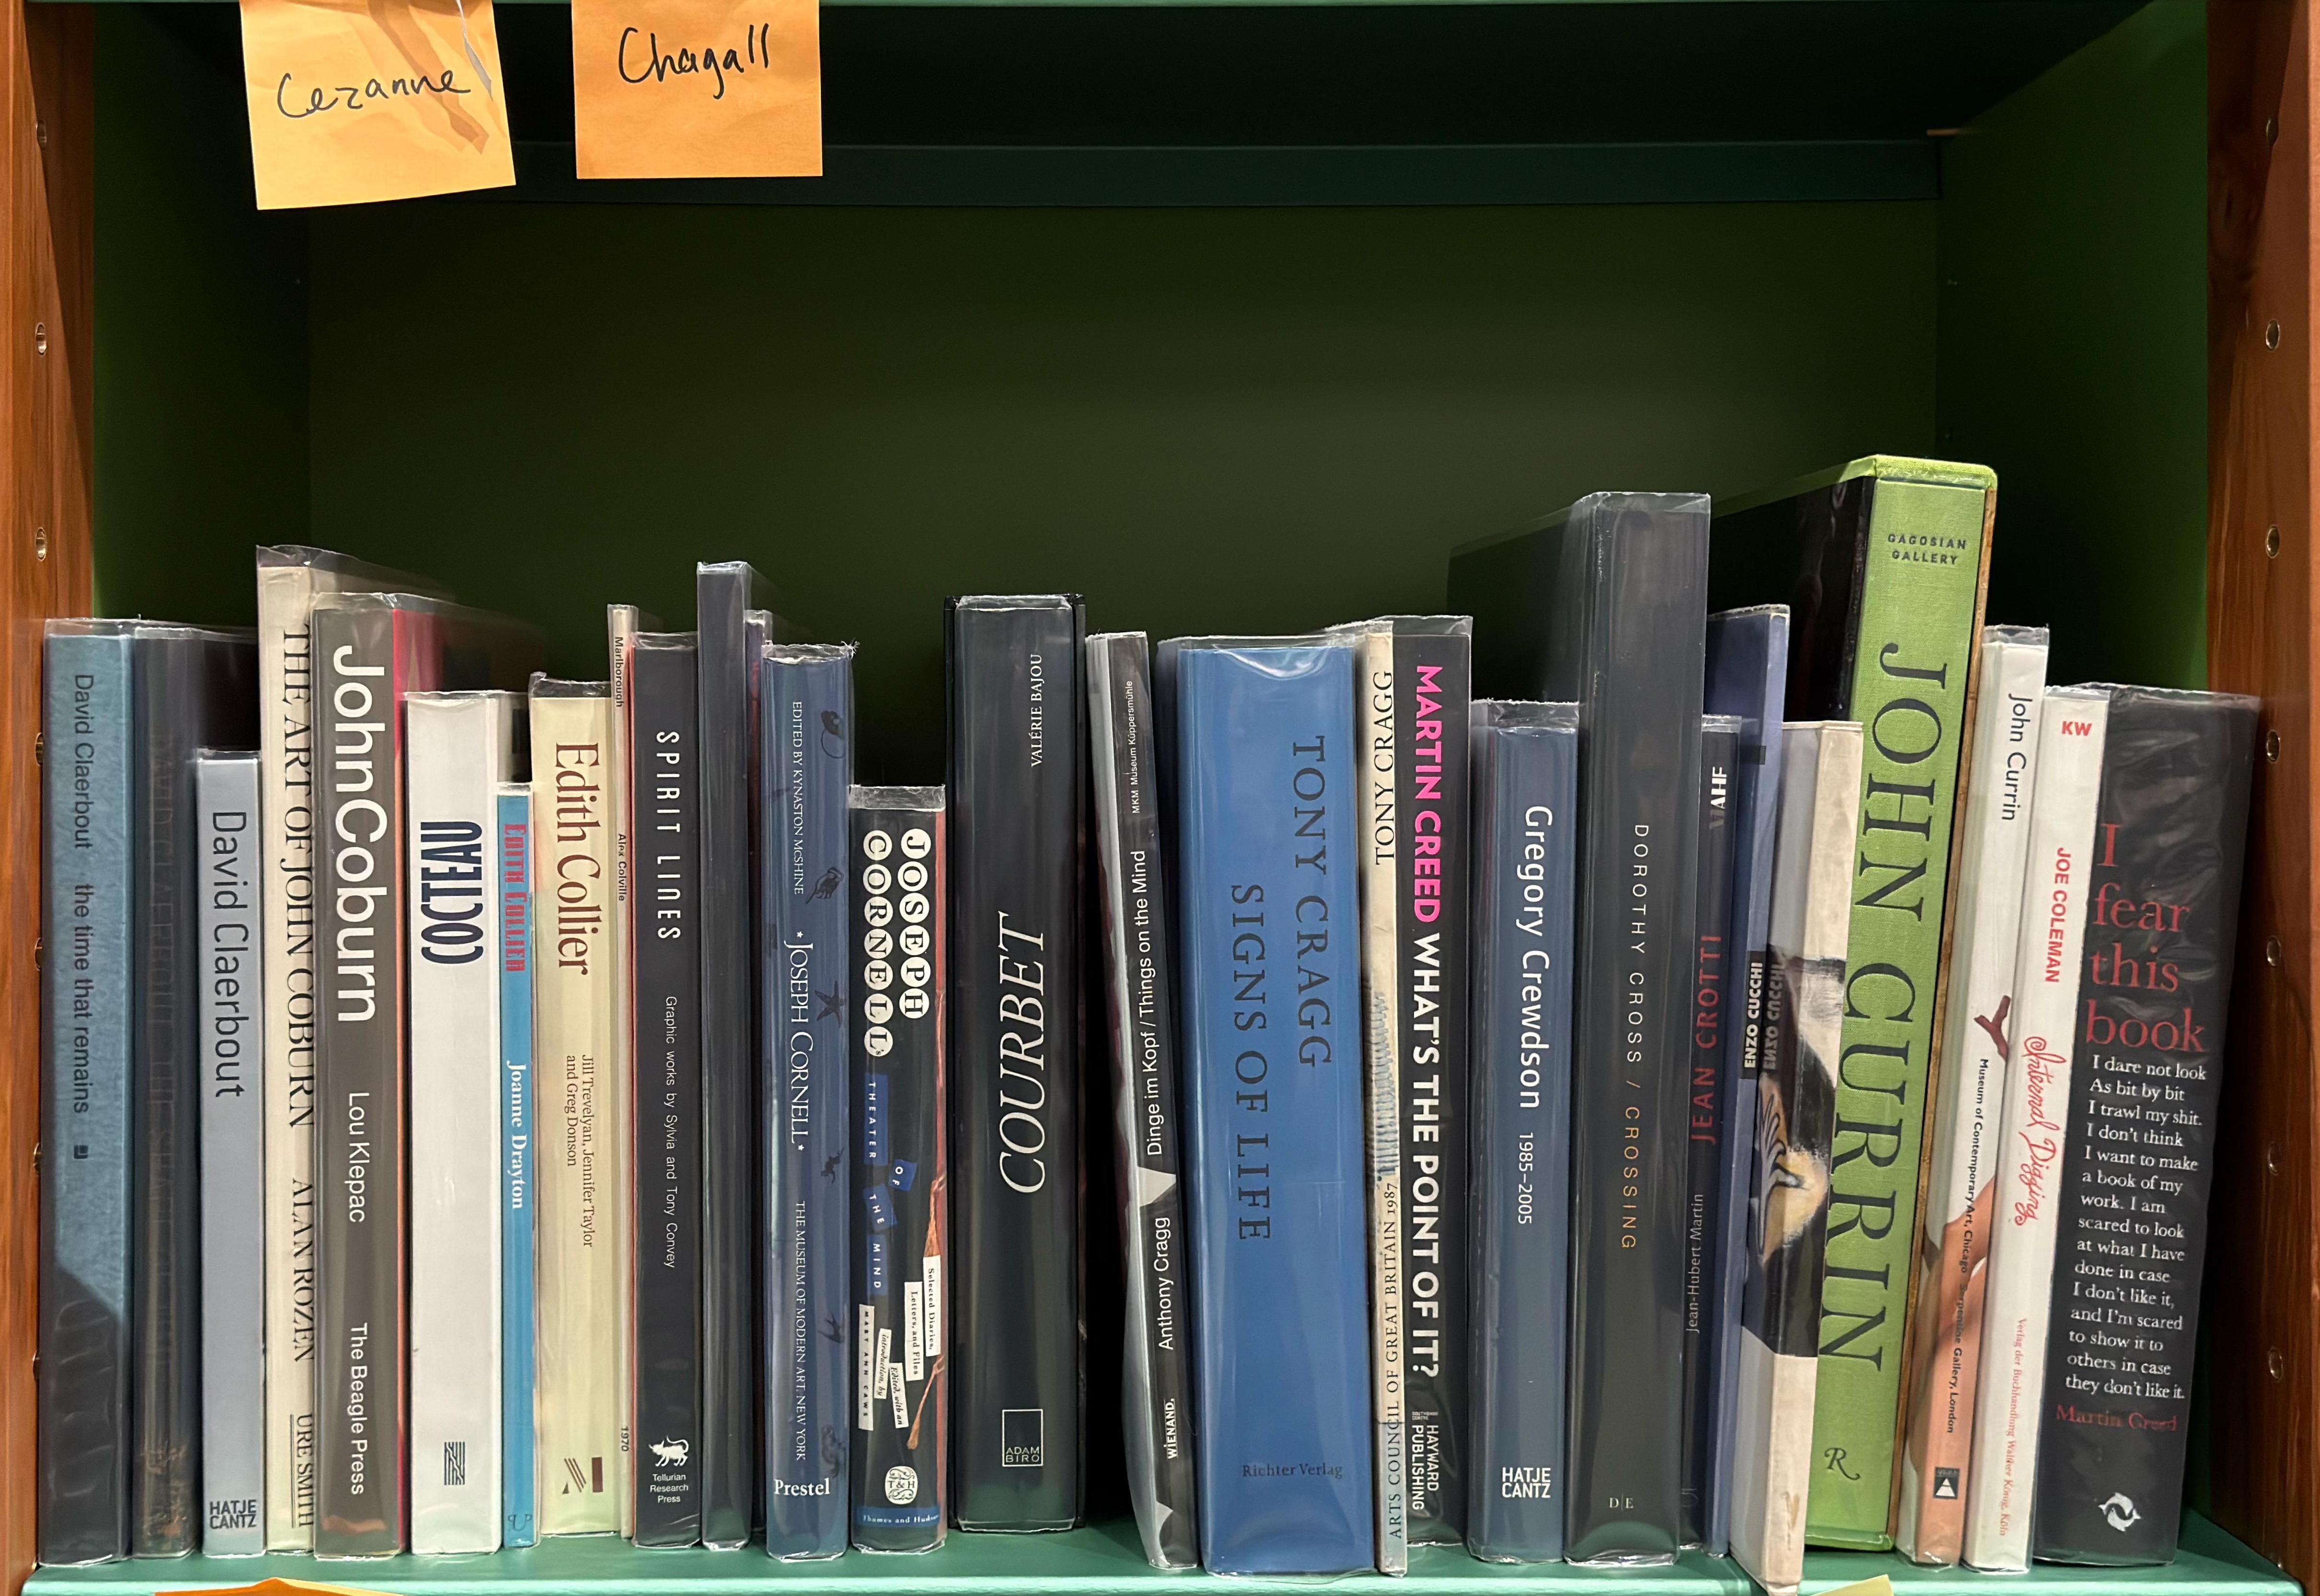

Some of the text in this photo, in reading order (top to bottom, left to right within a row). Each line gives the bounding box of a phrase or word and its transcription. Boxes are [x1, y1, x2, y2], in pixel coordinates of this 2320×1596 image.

[277, 68, 471, 118] Cezanne
[618, 23, 770, 99] Chagall
[1888, 534, 1967, 549] GAGOSIAN
[1892, 550, 1958, 565] GALLERY
[614, 637, 624, 707] Marlborough
[1028, 654, 1043, 767] VALÉRIE BAJOU
[74, 675, 94, 849] David Claerbout
[1372, 672, 1396, 865] TONY CRAGG
[2002, 693, 2033, 820] John Currin
[2062, 721, 2092, 737] KW
[280, 629, 314, 1127] THE ART OF JOHN COBURN
[556, 743, 601, 975] Edith Collier
[618, 833, 627, 901] Alex Colville
[656, 731, 682, 939] SPIRIT LINES
[1516, 806, 1552, 936] Gregory
[2097, 823, 2122, 867] I
[421, 821, 483, 965] COCTEAU
[903, 836, 925, 1014] JOSEPH
[1293, 735, 1332, 1068] TONY CRAGG
[2045, 848, 2072, 982] JOE COLEMAN
[2092, 883, 2192, 932] fear
[74, 885, 94, 1113] the time that remains
[212, 812, 249, 1097] David Claerbout
[1131, 851, 1164, 1156] Dinge im Kopf Things on the Mind
[1819, 642, 1947, 1372] JOHN CURRIN
[2089, 943, 2179, 992] this
[784, 941, 814, 1143] JOSEPH CORNELL
[997, 911, 1046, 1193] COURBET
[1231, 885, 1271, 1240] SIGNS OF LIFE
[1412, 665, 1442, 1377] MARTIN CREED WHAT'S THE POINT OF IT?
[1520, 950, 1550, 1107] Crewdson
[1621, 825, 1649, 1248] DOROTHY CROSS CROSSING
[1691, 937, 1722, 1145] JEAN CROTTI
[1744, 963, 1763, 1068] ENZO CUCCHI
[2086, 1000, 2206, 1053] book
[2093, 1055, 2207, 1080] I dare not look
[507, 1060, 527, 1209] Joanne Drayton
[564, 1055, 579, 1167] and Greg Donson
[664, 996, 678, 1268] Graphic works by Sylvia and Tony Convey
[868, 1083, 876, 1158] THEATER
[2014, 1037, 2067, 1226] Internal Digging
[2088, 1100, 2203, 1126] I trawl my shit.
[2090, 1077, 2185, 1101] As bit by bit
[345, 1092, 370, 1222] Lou Klepac
[579, 1055, 596, 1247] Jill Trevelyan, Jennifer Taylor
[892, 1166, 903, 1186] OF
[1959, 1059, 1989, 1273] Museum of Contemporary Art, Chicago
[869, 1194, 885, 1224] THE
[1686, 1195, 1704, 1334] Jean-Hubert Martin
[2078, 1217, 2185, 1238] scared to look
[873, 1243, 881, 1288] MIND
[1152, 1217, 1174, 1350] Anthony Cragg
[347, 1323, 368, 1495] The Beagle Press
[2055, 1403, 2177, 1432] Martin Creed
[2067, 1353, 2171, 1375] others in case
[621, 1426, 629, 1452] 1970
[774, 1478, 830, 1496] Prestel
[1006, 1446, 1039, 1455] ADAM
[1242, 1462, 1342, 1479] Richter Verlag
[1412, 1425, 1425, 1510] PUBLISHING
[1427, 1425, 1439, 1491] HAYWARD
[1502, 1467, 1551, 1482] HATJE
[1502, 1482, 1551, 1498] CANTZ
[210, 1500, 257, 1515] HATJE
[210, 1514, 257, 1529] CANTZ
